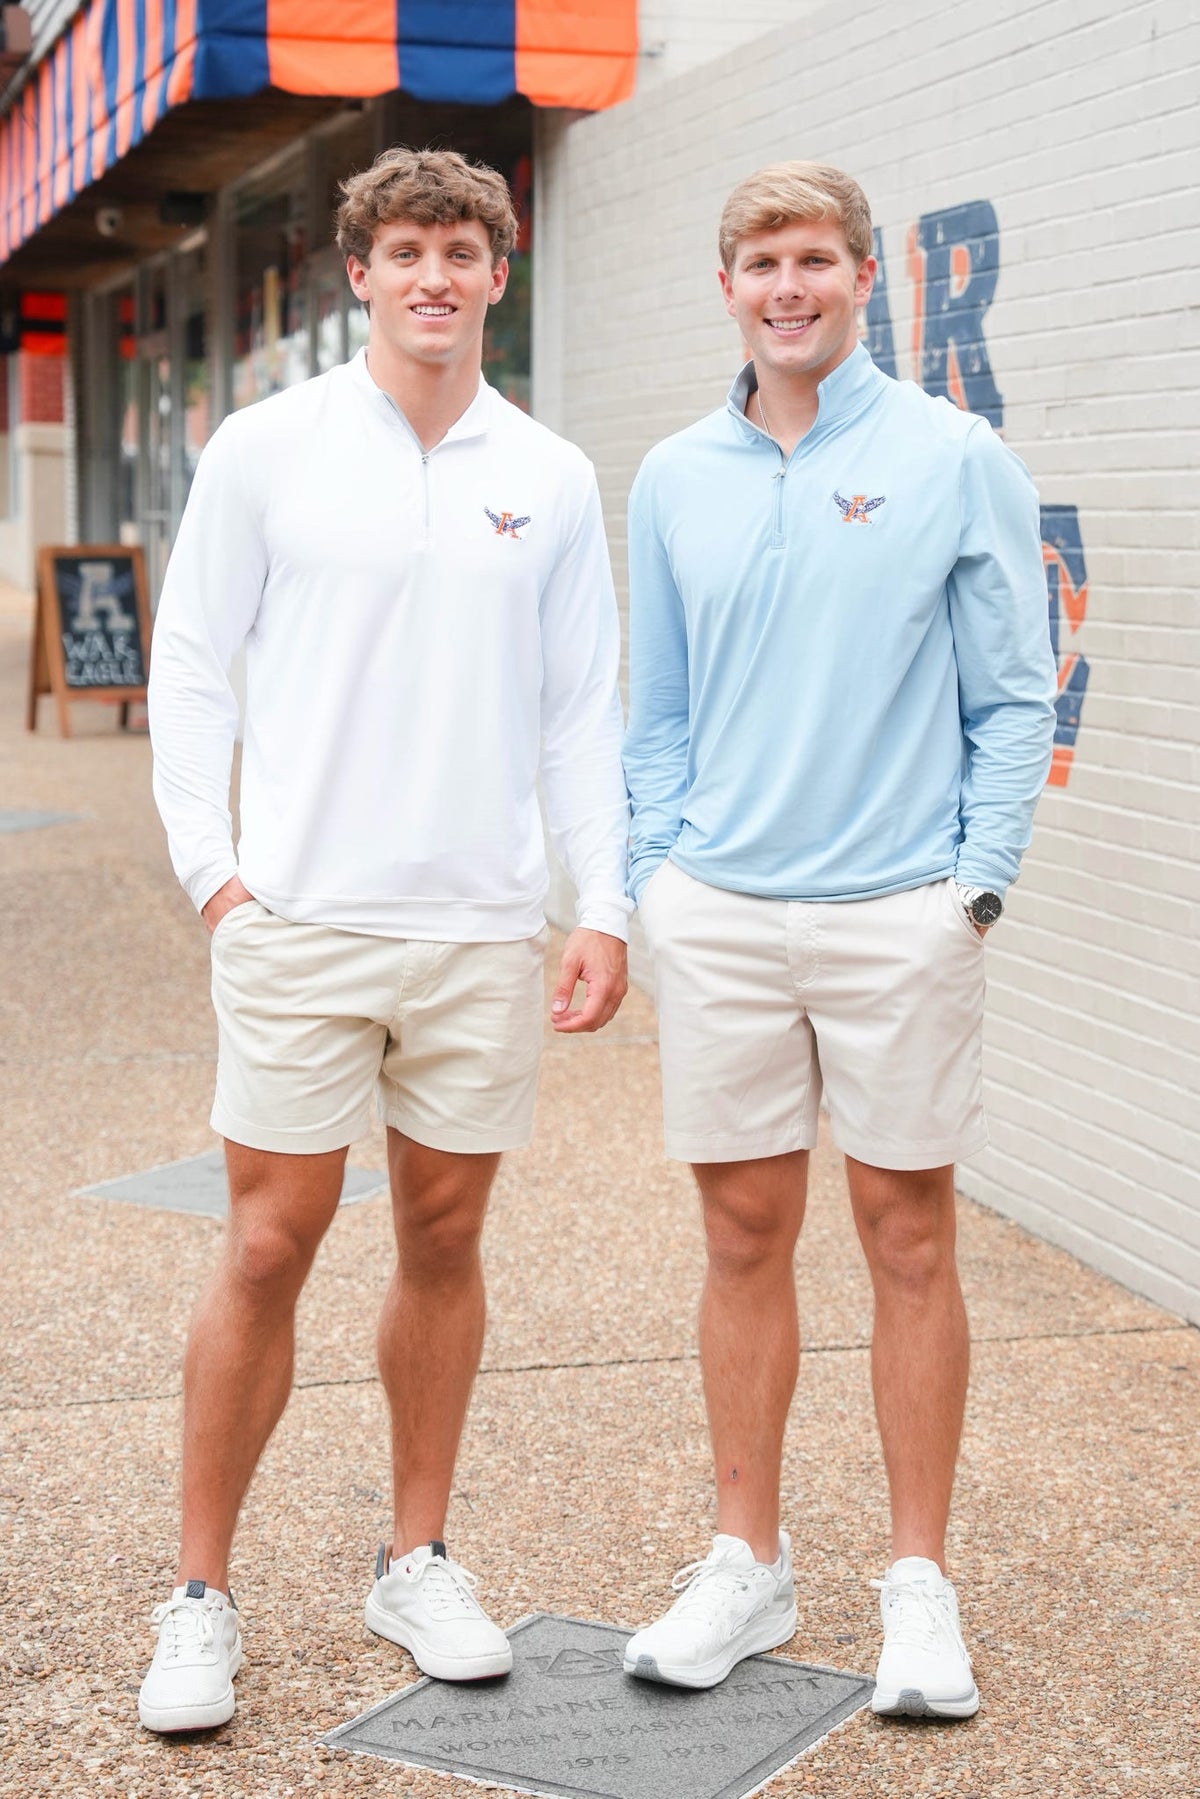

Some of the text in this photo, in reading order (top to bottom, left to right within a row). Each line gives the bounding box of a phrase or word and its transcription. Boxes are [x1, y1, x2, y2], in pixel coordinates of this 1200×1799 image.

[392, 1698, 626, 1733] MARIANNE
[437, 1707, 817, 1754] WOMEN'S BASKETBALL
[563, 1753, 630, 1769] 1975
